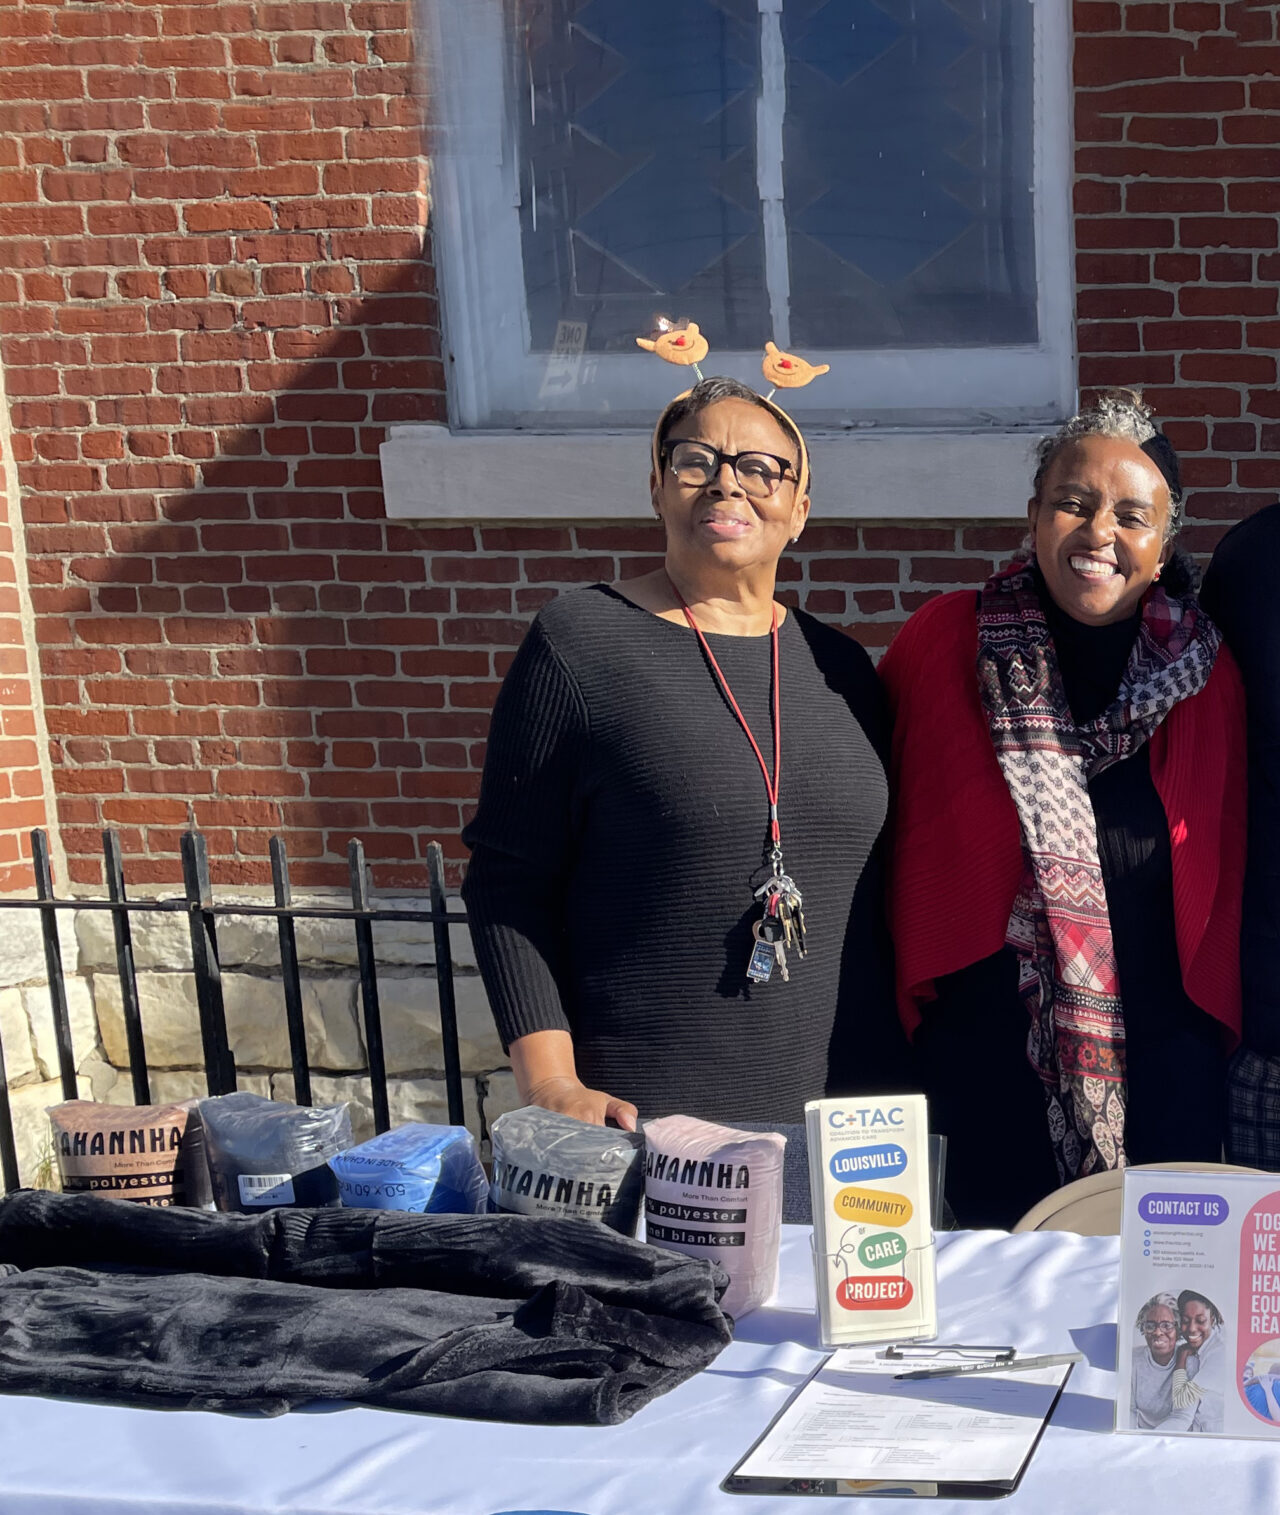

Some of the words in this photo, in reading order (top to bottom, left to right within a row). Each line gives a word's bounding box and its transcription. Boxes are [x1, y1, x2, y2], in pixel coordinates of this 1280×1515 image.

[364, 1157, 376, 1166] IN
[376, 1159, 408, 1170] MADE
[834, 1151, 903, 1173] LOUISVILLE
[90, 1174, 174, 1190] polyester
[354, 1184, 371, 1197] 60
[385, 1184, 406, 1198] 50
[682, 1192, 699, 1200] More
[700, 1193, 719, 1202] Than
[659, 1203, 738, 1221] polyester
[841, 1195, 907, 1216] COMMUNITY
[1148, 1200, 1201, 1216] CONTACT
[1204, 1202, 1220, 1217] US
[672, 1231, 736, 1245] blanket
[1253, 1233, 1277, 1252] WE
[864, 1238, 902, 1262] CARE
[845, 1282, 906, 1299] PROJECT
